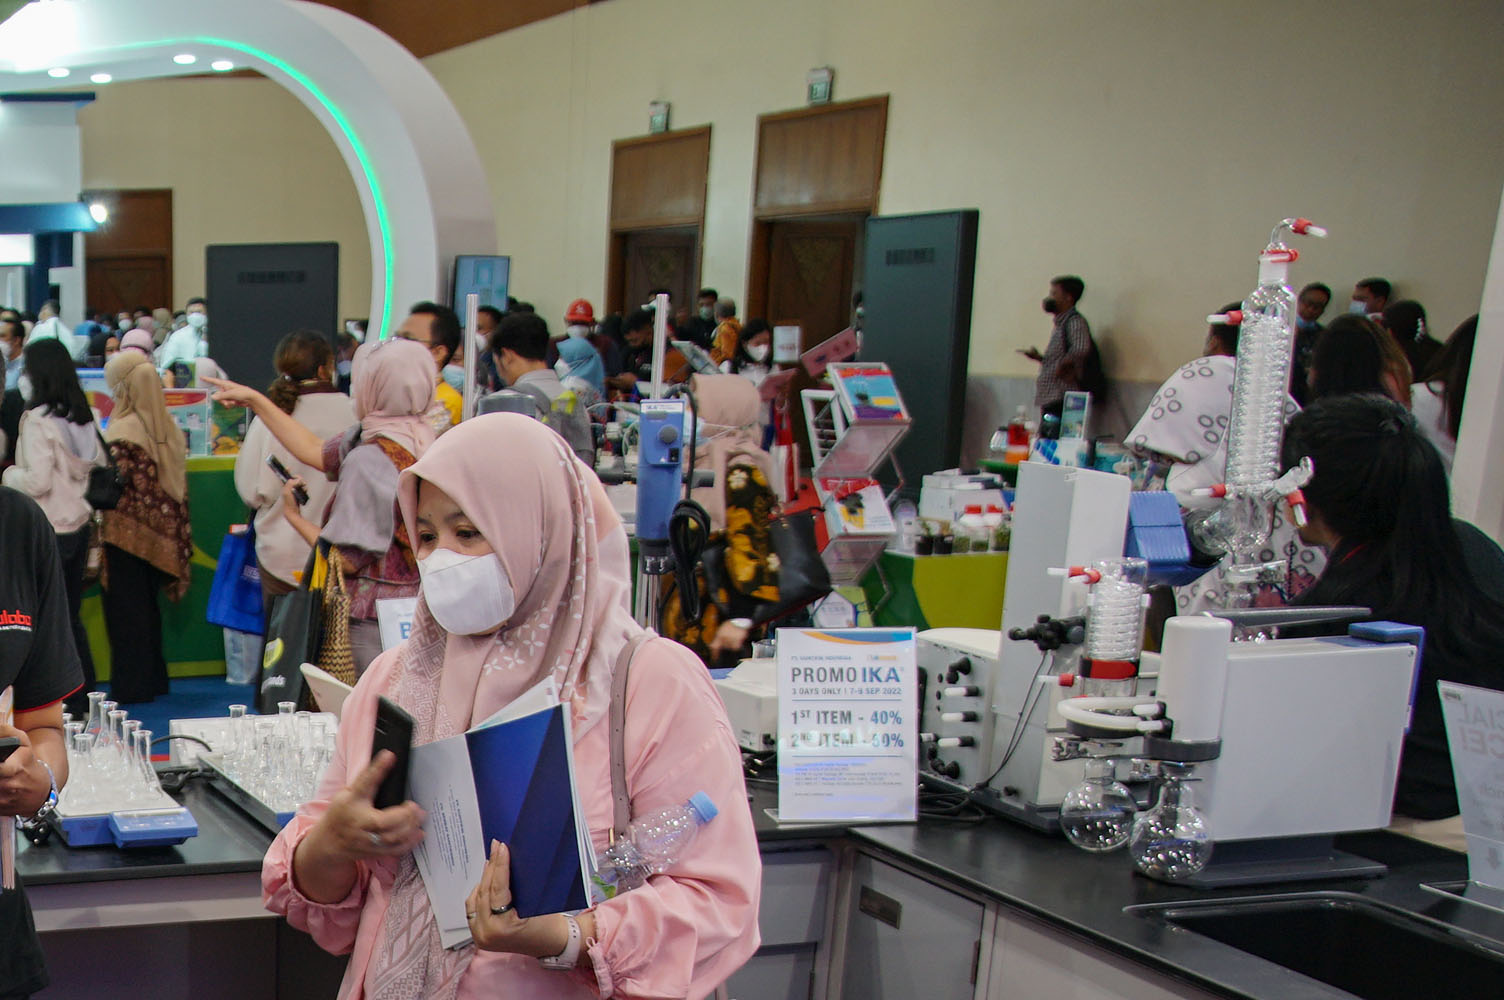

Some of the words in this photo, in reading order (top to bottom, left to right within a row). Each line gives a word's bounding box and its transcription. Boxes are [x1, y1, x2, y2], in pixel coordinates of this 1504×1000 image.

[791, 666, 857, 683] PROMO
[862, 666, 901, 683] IKA
[792, 687, 797, 695] 3
[799, 687, 819, 695] DAYS
[822, 687, 842, 695] ONLY
[866, 687, 881, 695] SEP
[883, 687, 902, 695] 2022
[791, 710, 811, 725] 1ST
[816, 710, 852, 725] ITEM
[870, 710, 902, 725] 40%
[818, 732, 854, 748] ITEM
